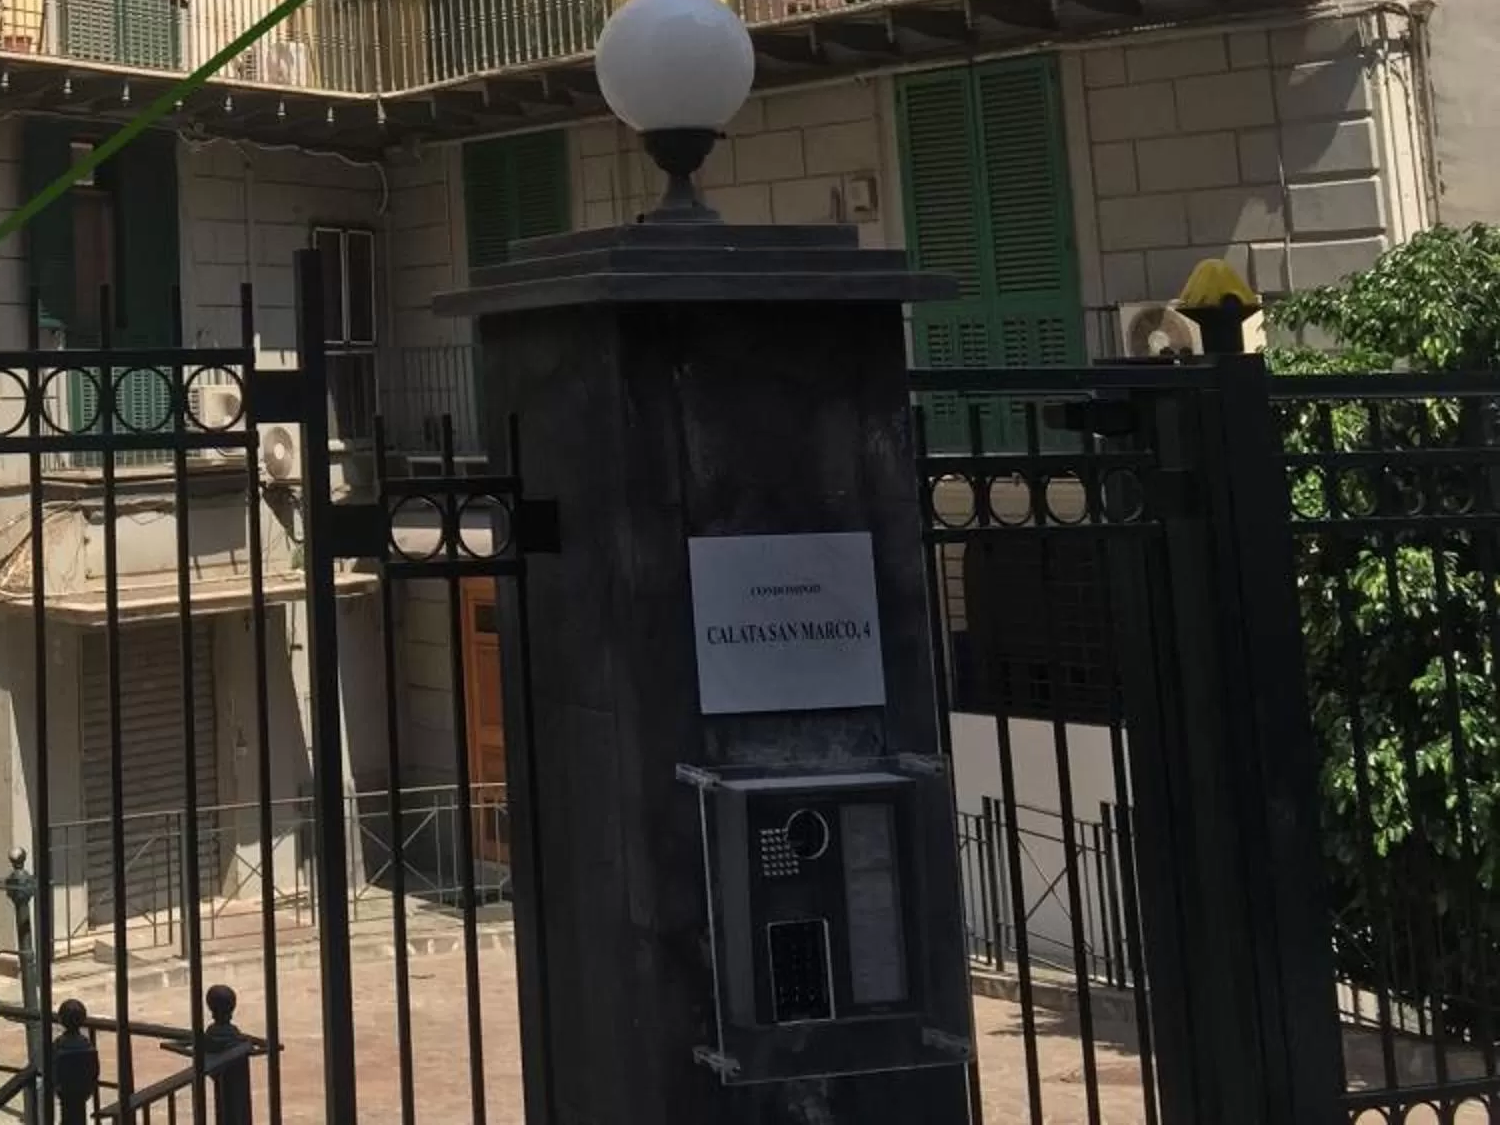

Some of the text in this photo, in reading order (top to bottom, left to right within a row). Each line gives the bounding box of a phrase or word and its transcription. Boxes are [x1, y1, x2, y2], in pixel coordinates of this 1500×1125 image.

[706, 623, 767, 646] CALATA
[767, 622, 798, 642] SAN
[863, 620, 871, 639] 4
